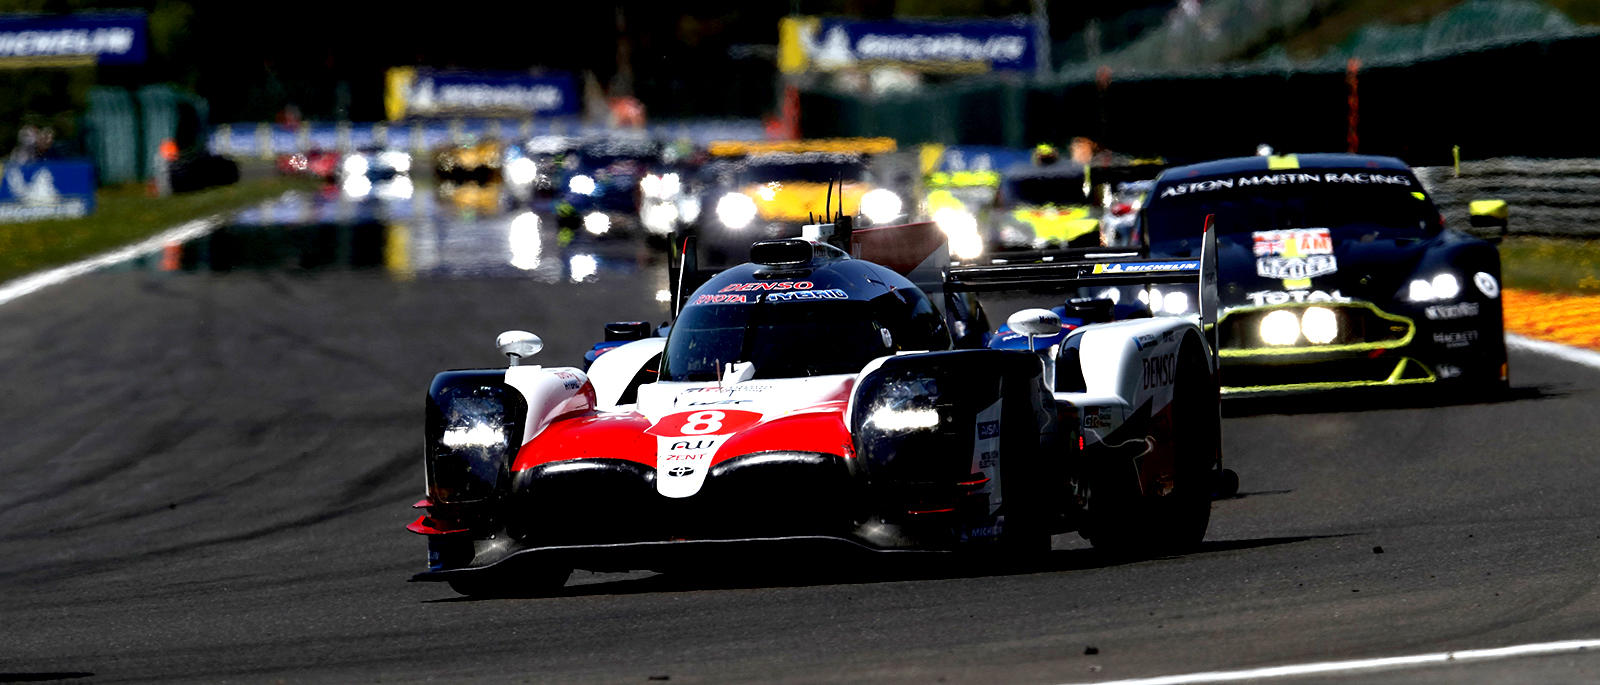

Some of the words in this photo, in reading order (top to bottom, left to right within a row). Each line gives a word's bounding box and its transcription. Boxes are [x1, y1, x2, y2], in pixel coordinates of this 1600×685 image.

[1160, 178, 1234, 199] ASTON
[1238, 173, 1320, 187] MARTIN
[1324, 173, 1412, 186] RACING
[1125, 263, 1197, 272] MICHELIN
[718, 281, 814, 293] DENSO
[753, 288, 849, 304] HYBRID
[1246, 290, 1352, 306] TOTAL
[1142, 352, 1175, 390] DENSO
[680, 410, 726, 435] 8
